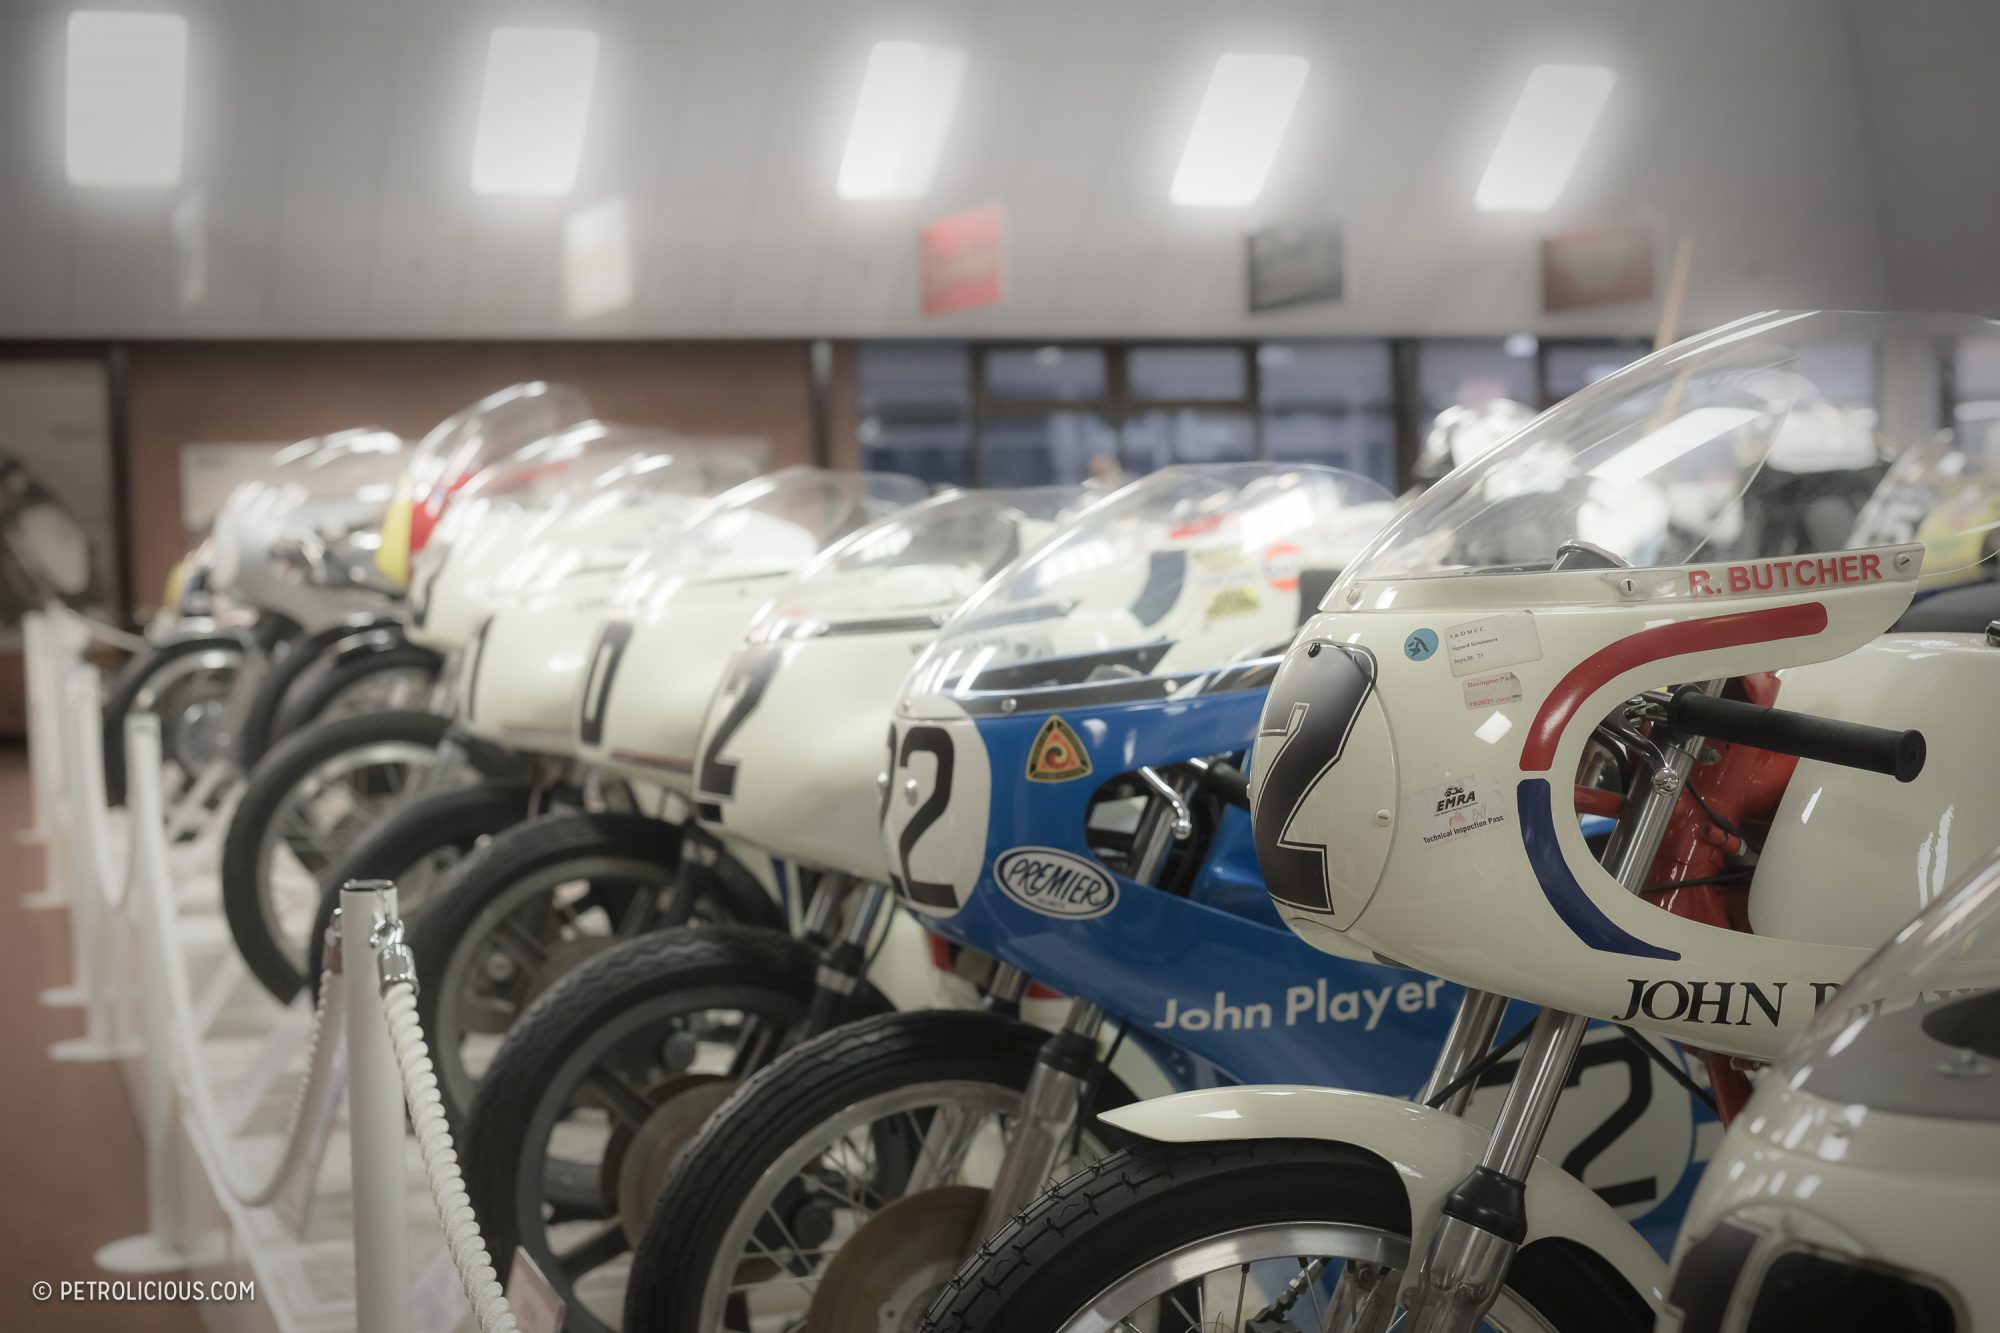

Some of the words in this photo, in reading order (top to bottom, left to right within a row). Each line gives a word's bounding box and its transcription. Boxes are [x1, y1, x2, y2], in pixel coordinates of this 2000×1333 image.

[1688, 570, 1722, 598] R.
[1728, 554, 1882, 592] BUTCHER
[1467, 678, 1499, 688] Donington
[1255, 640, 1378, 915] 2
[1436, 791, 1476, 812] EMRA
[1422, 830, 1453, 844] Technical
[1453, 820, 1487, 834] Inspection
[1487, 815, 1504, 825] Pass
[1007, 858, 1106, 906] PREMIER
[1154, 991, 1273, 1031] John
[1285, 977, 1446, 1032] Player
[1612, 979, 1788, 1027] JOHN
